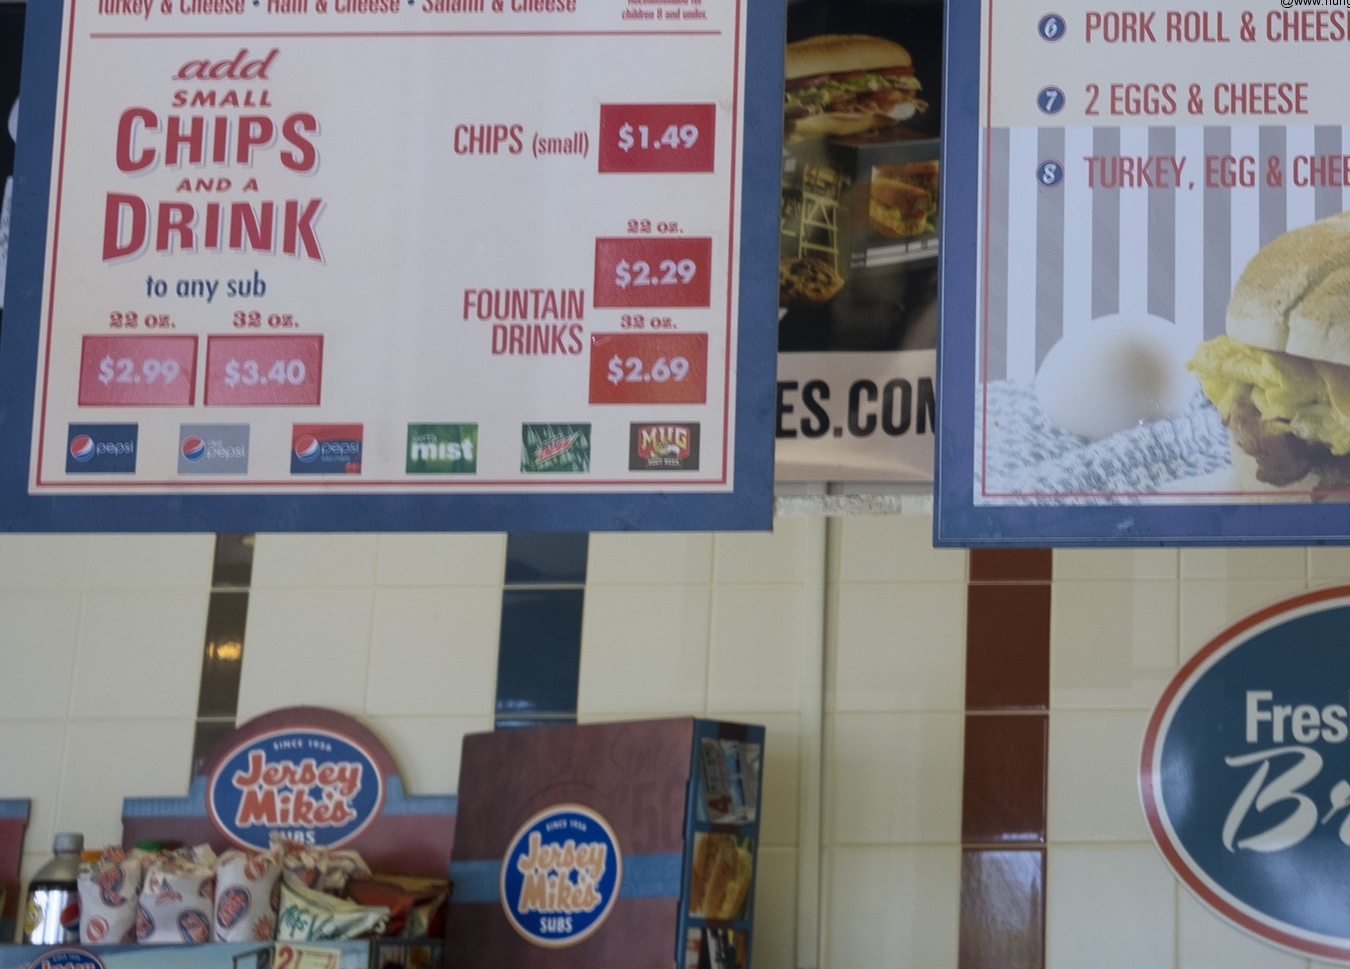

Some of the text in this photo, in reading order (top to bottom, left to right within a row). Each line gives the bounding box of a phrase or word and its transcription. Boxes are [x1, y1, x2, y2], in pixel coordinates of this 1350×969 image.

[172, 47, 281, 83] add
[172, 90, 272, 108] SMALL
[1045, 82, 1309, 116] 7 2 EGGS & CHEESE
[115, 107, 317, 173] CHIPS
[453, 124, 589, 159] CHIPS (small)
[618, 122, 699, 153] $1.49
[176, 177, 259, 192] AND A
[1042, 163, 1057, 184] 8
[1084, 155, 1194, 189] TURKEY,
[1205, 154, 1256, 189] EGG
[1265, 155, 1283, 188] &
[101, 192, 322, 262] DRINK
[146, 270, 267, 303] to any sub
[614, 258, 697, 290] $2.29
[109, 311, 176, 329] 22 oz.
[232, 311, 299, 328] 32 oz.
[463, 288, 585, 321] FOUNTAIN
[491, 323, 584, 355] DRINKS
[98, 355, 181, 386] $2.99
[223, 357, 306, 389] $3.40
[607, 354, 690, 385] $2.69
[95, 438, 134, 457] pepsi
[206, 444, 247, 459] pepsi
[410, 441, 475, 461] mist
[640, 425, 689, 451] MUG
[272, 738, 304, 752] SINCE
[232, 749, 363, 799] Jersey
[236, 784, 358, 828] Mike's
[518, 832, 608, 880] Jersey
[518, 870, 603, 914] Mike's
[539, 917, 574, 935] SUBS
